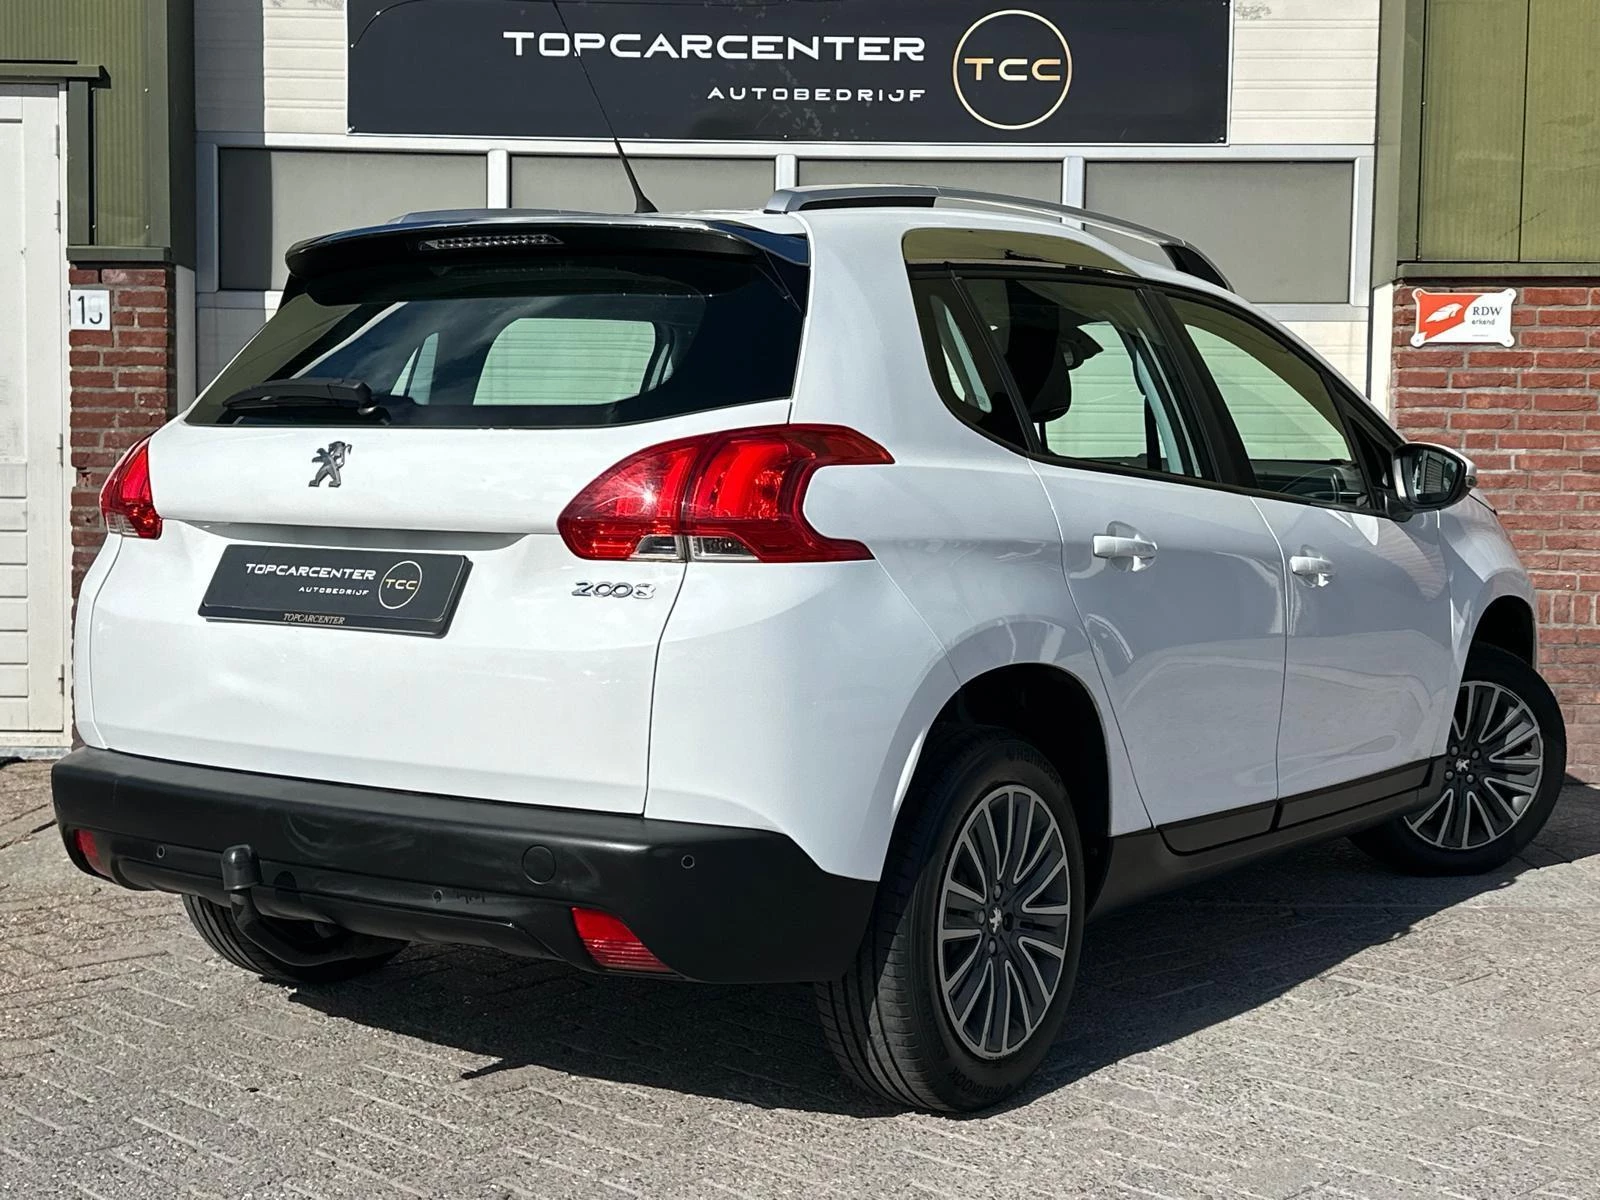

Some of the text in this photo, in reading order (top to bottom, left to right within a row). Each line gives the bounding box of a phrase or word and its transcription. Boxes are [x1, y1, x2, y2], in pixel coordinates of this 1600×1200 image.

[503, 31, 925, 62] TOPCARCENTER
[964, 58, 1060, 81] TCC
[706, 86, 925, 103] AUTOBEDRIJF
[1472, 306, 1502, 316] RDW
[1471, 318, 1496, 326] erkend
[245, 563, 376, 581] TOPCARCENTER
[298, 586, 370, 596] AUTOBEDRIJF
[384, 578, 419, 590] TCC
[571, 581, 657, 600] 2008
[283, 613, 346, 625] TOPCARCENTER
